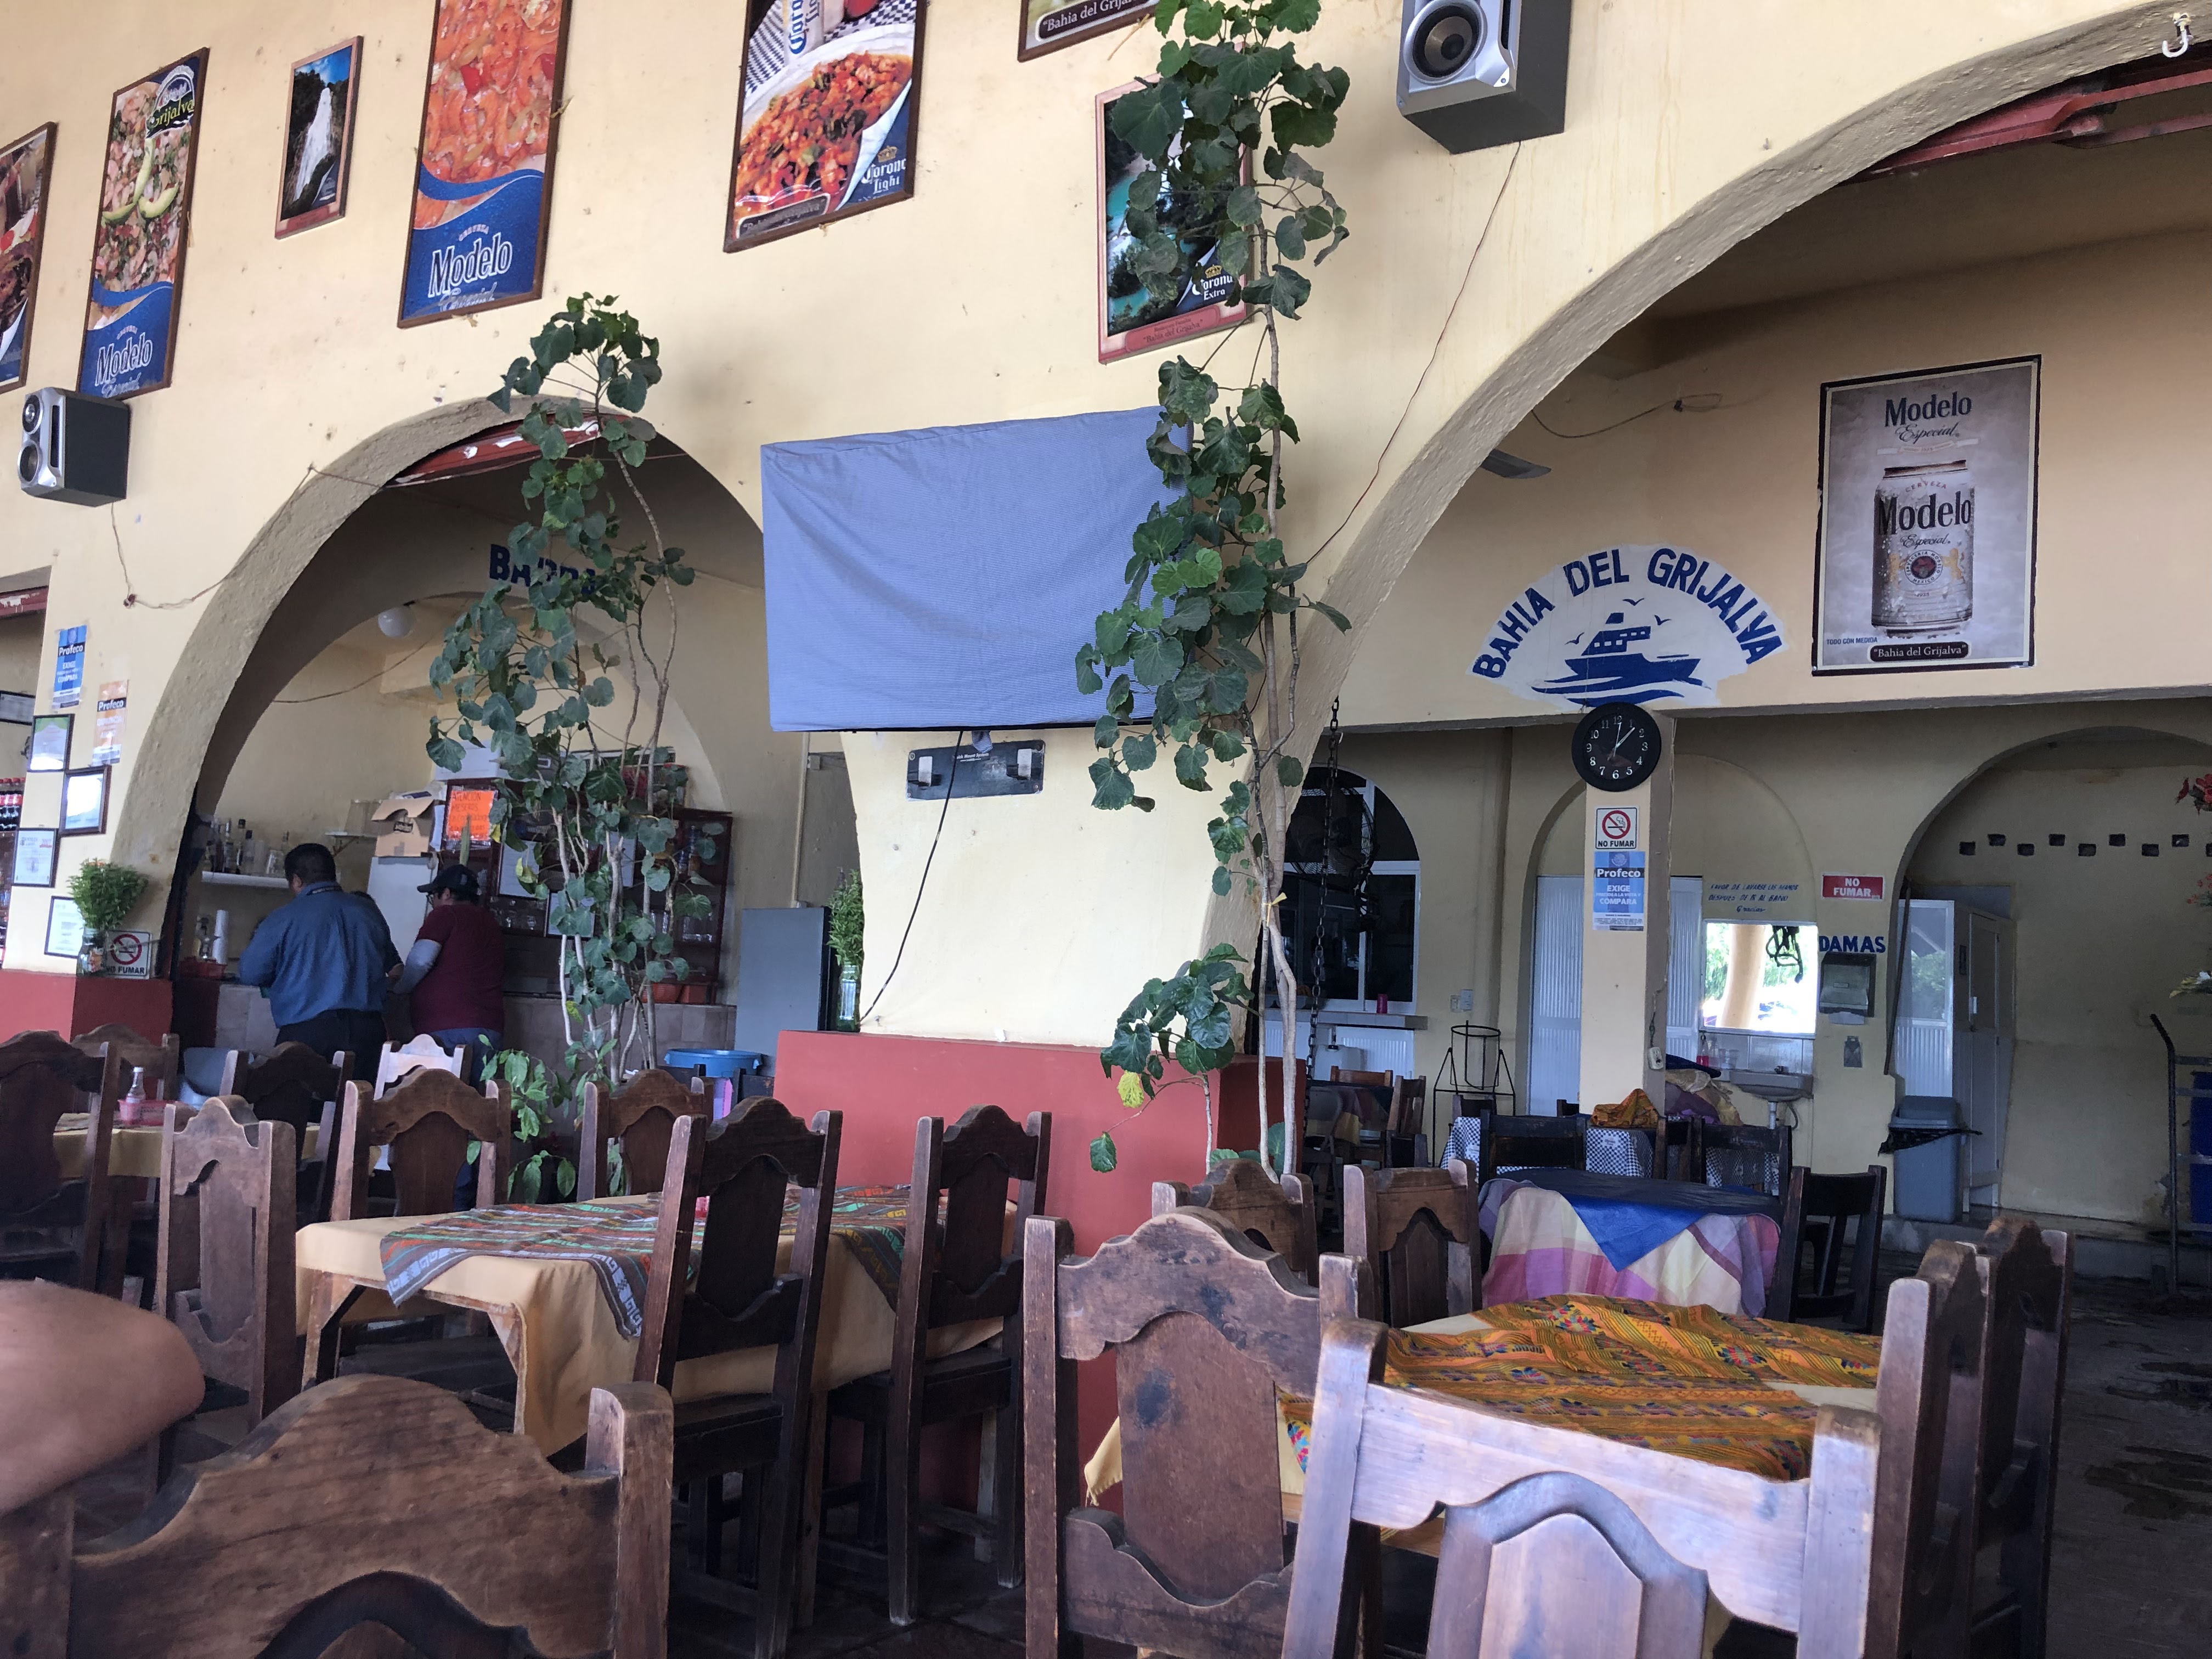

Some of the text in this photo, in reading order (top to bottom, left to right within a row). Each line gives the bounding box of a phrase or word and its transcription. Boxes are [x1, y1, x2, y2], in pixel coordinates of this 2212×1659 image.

[1080, 3, 1097, 19] del
[1100, 0, 1132, 11] Grija
[788, 0, 809, 54] Coro
[873, 176, 900, 194] Light
[428, 232, 512, 298] Modelo
[1204, 289, 1226, 301] Extra
[95, 332, 153, 387] Modelo
[1884, 391, 1972, 427] Modelo
[1905, 481, 1947, 493] CERVEZA
[1878, 491, 1971, 535] Modelo
[1472, 548, 1782, 678] BAHIA DEL GRIJALVA
[57, 645, 83, 656] Profeco
[1906, 647, 1921, 656] del
[99, 700, 124, 711] Profeco
[1601, 720, 1609, 729] 11
[1613, 715, 1622, 725] 12
[1629, 719, 1633, 728] 1
[1590, 730, 1599, 739] 10
[1639, 729, 1644, 737] 2
[1586, 743, 1592, 752] 9
[1641, 742, 1648, 751] 3
[1590, 757, 1596, 766] 8
[1636, 756, 1643, 765] 4
[1599, 766, 1606, 775] 7
[1612, 770, 1619, 779] 6
[1626, 766, 1633, 775] 5
[1597, 868, 1641, 877] Profeco
[1845, 878, 1860, 887] NO
[1833, 888, 1871, 896] FUMAR
[1819, 935, 1886, 953] DAMAS
